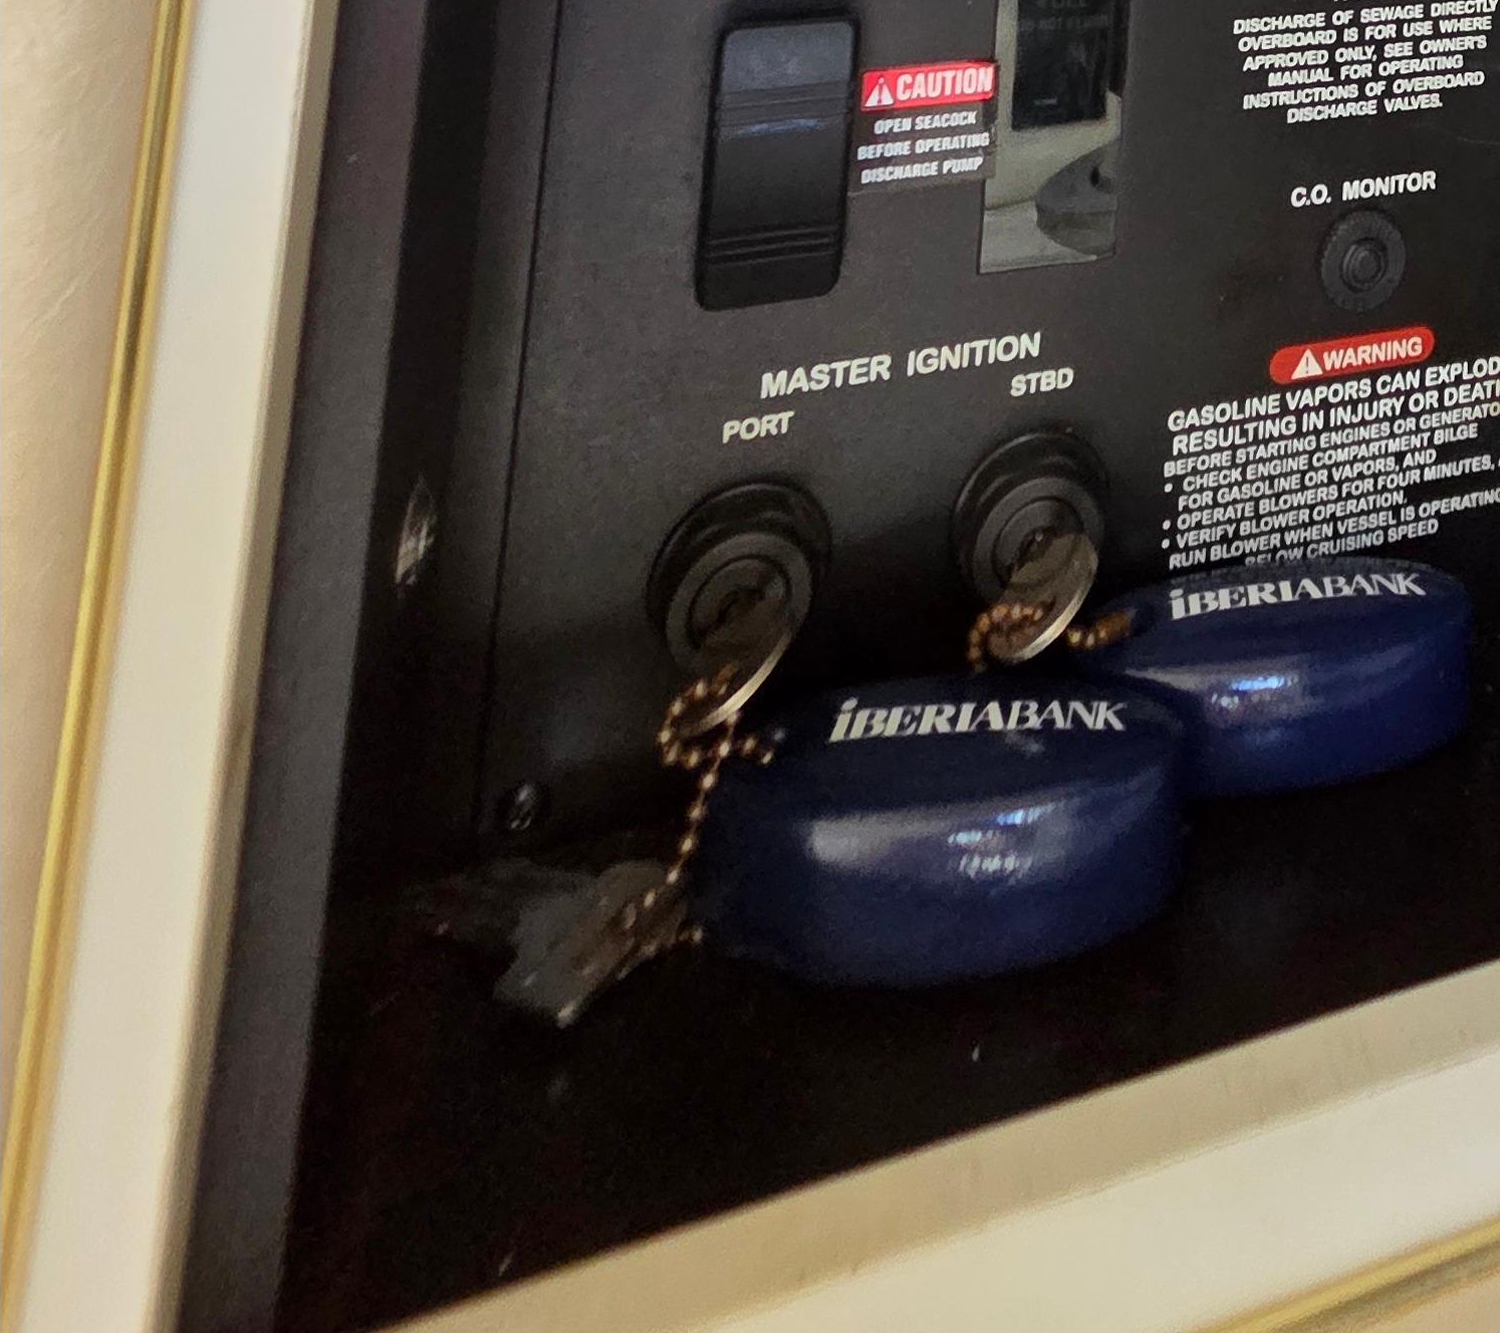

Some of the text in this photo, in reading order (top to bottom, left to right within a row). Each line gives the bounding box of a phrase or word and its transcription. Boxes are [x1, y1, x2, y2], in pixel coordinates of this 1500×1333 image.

[1233, 13, 1325, 34] DISCHARGE
[1332, 10, 1354, 25] OF
[1360, 4, 1424, 23] SEWAGE
[1238, 16, 1492, 51] OVERBOARD IS FOR USE WHERE
[1243, 50, 1328, 71] APPROVED
[1384, 42, 1413, 58] SEE
[1419, 35, 1487, 54] OWNER'S
[1268, 54, 1463, 87] MANUAL FOR OPERATING
[897, 67, 993, 100] CAUTION
[1243, 71, 1485, 109] INSTRUCTIONS OF OVERBOARD
[875, 111, 977, 134] OPEN SEACOCK
[1287, 100, 1377, 123] DISCHARGE
[858, 132, 990, 160] BEFORE OPERATING
[862, 157, 983, 183] DISCHARGE PUMP
[1342, 171, 1436, 200] MONITOR
[761, 332, 1040, 398] MASTER IGNITION
[1323, 336, 1422, 371] WARNING
[1010, 368, 1073, 396] STBD
[1168, 394, 1280, 431] GASOLINE
[1286, 378, 1371, 410] VAPORS
[1376, 369, 1420, 395] CAN
[723, 411, 794, 443] PORT
[1173, 415, 1296, 456] RESULTING
[1302, 410, 1324, 432] IN
[1330, 396, 1404, 427] INJURY
[1409, 391, 1438, 412] OR
[1164, 450, 1232, 477] BEFORE
[1236, 435, 1316, 463] STARTING
[1320, 422, 1390, 448] ENGINES
[1393, 418, 1416, 434] OR
[1183, 423, 1478, 492] CHECK ENGINE COMPARTMENT BILGE
[1179, 491, 1213, 511] FOR
[1217, 474, 1301, 503] GASOLINE
[1305, 469, 1328, 486] OR
[1403, 449, 1436, 468] AND
[1177, 501, 1254, 530] OPERATE
[1259, 485, 1338, 514] BLOWERS
[1342, 478, 1374, 497] FOR
[1377, 469, 1420, 490] FOUR
[1169, 548, 1206, 569] RUN
[1210, 533, 1280, 561] BLOWER
[1284, 522, 1333, 545] WHEN
[1337, 511, 1396, 534] VESSEL
[1401, 506, 1415, 522] IS
[1176, 523, 1236, 548] VERIFY
[1240, 509, 1309, 536] BLOWER
[1307, 518, 1438, 558] CRUISING SPEED
